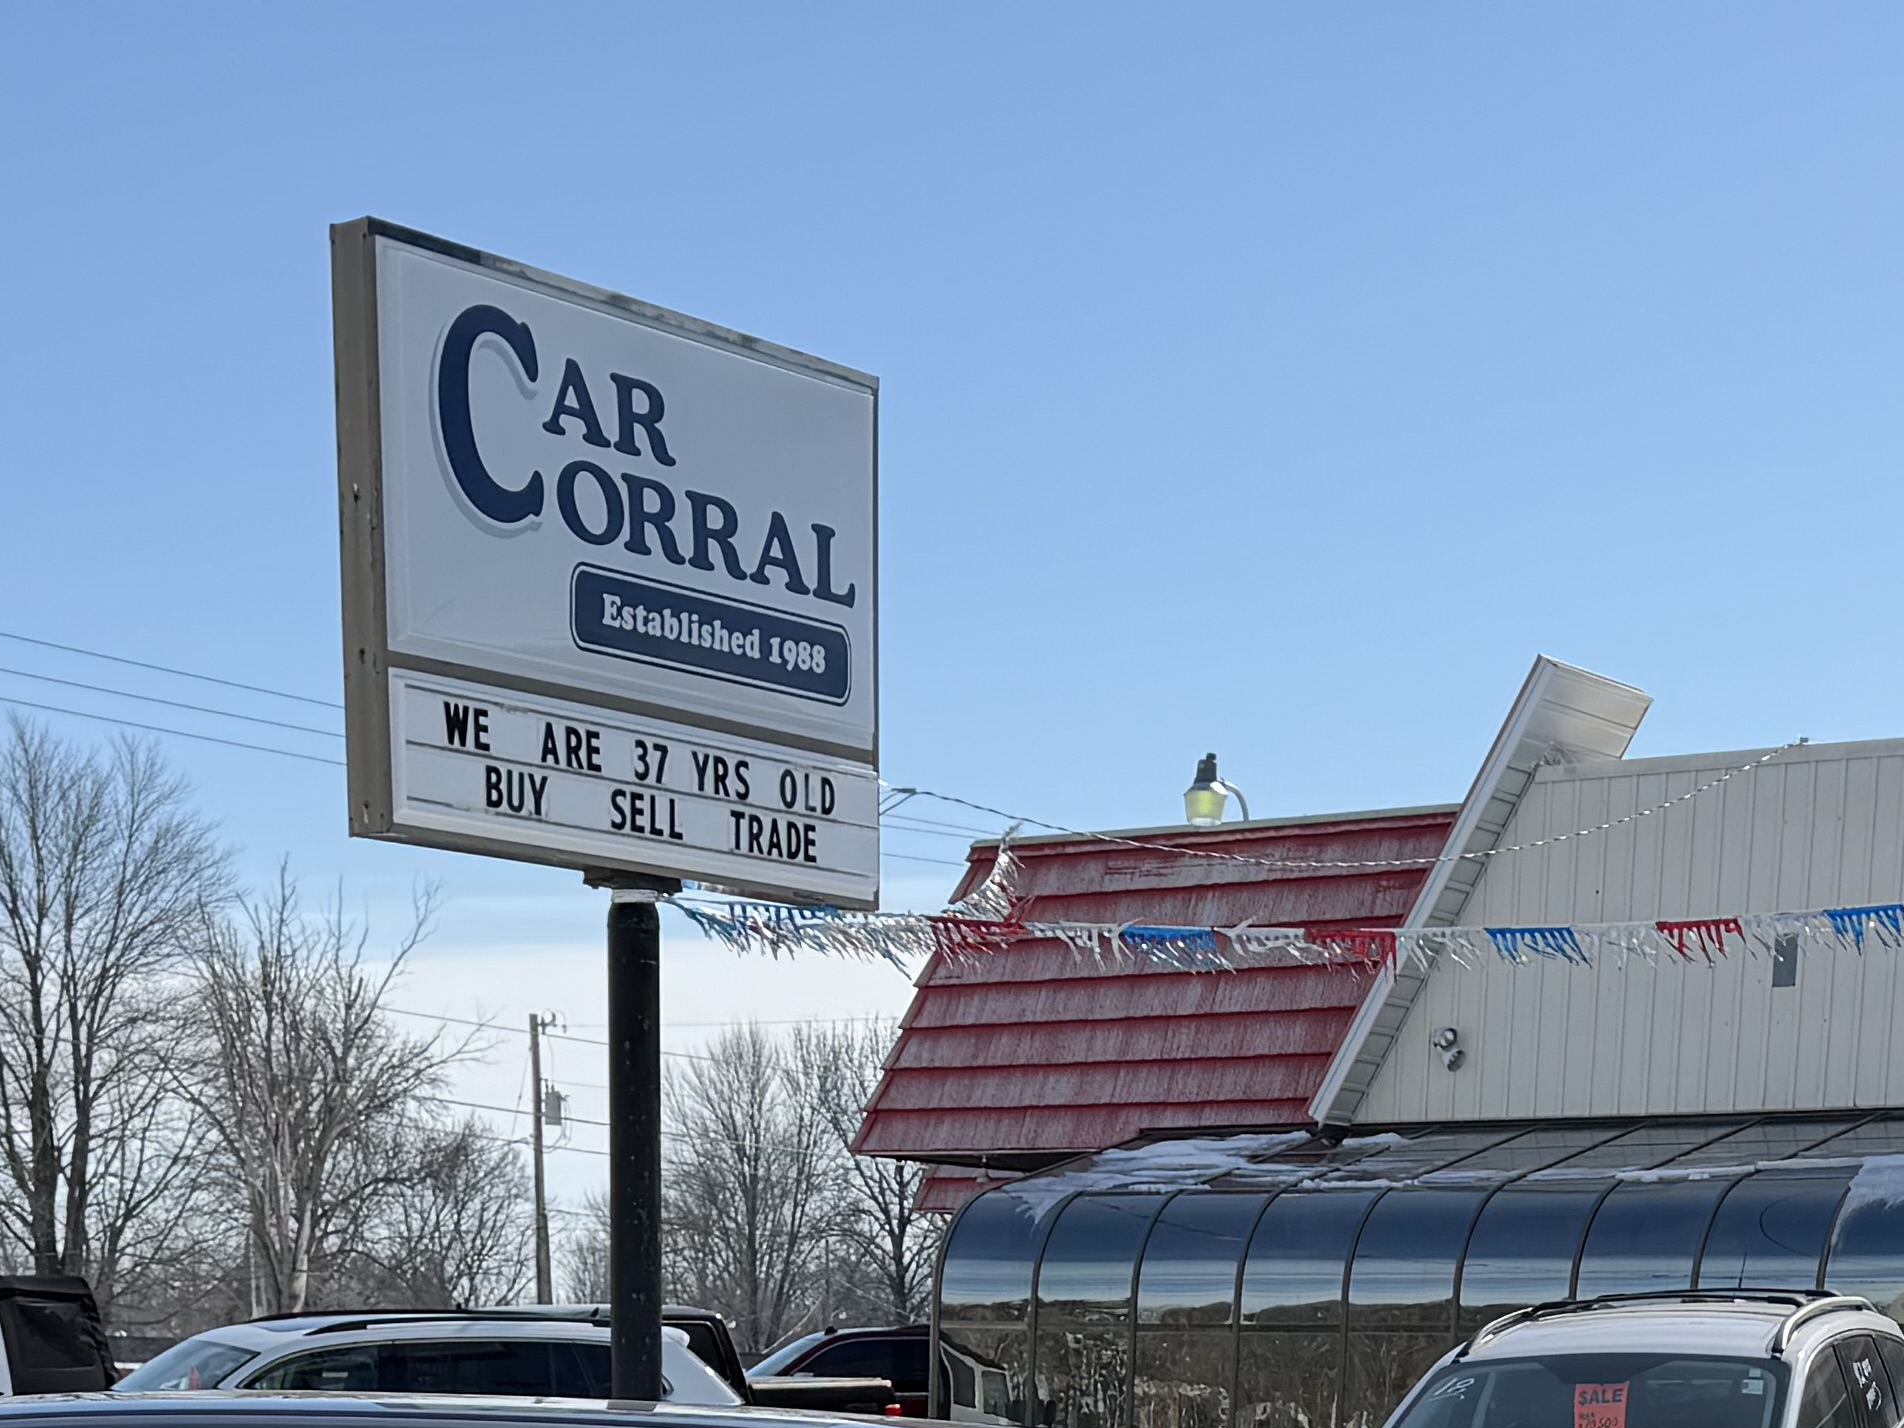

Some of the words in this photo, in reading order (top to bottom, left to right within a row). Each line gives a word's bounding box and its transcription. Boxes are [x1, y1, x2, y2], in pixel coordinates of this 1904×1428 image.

[438, 304, 676, 523] CAR
[602, 593, 761, 659] Established
[769, 637, 826, 674] 1988
[443, 701, 490, 752] WE
[541, 721, 602, 773] ARE
[634, 739, 668, 784] 37
[692, 751, 750, 800] YRS
[780, 769, 835, 815] OLD
[485, 765, 548, 816] BUY
[611, 788, 683, 841] SELL
[730, 809, 817, 863] TRADE
